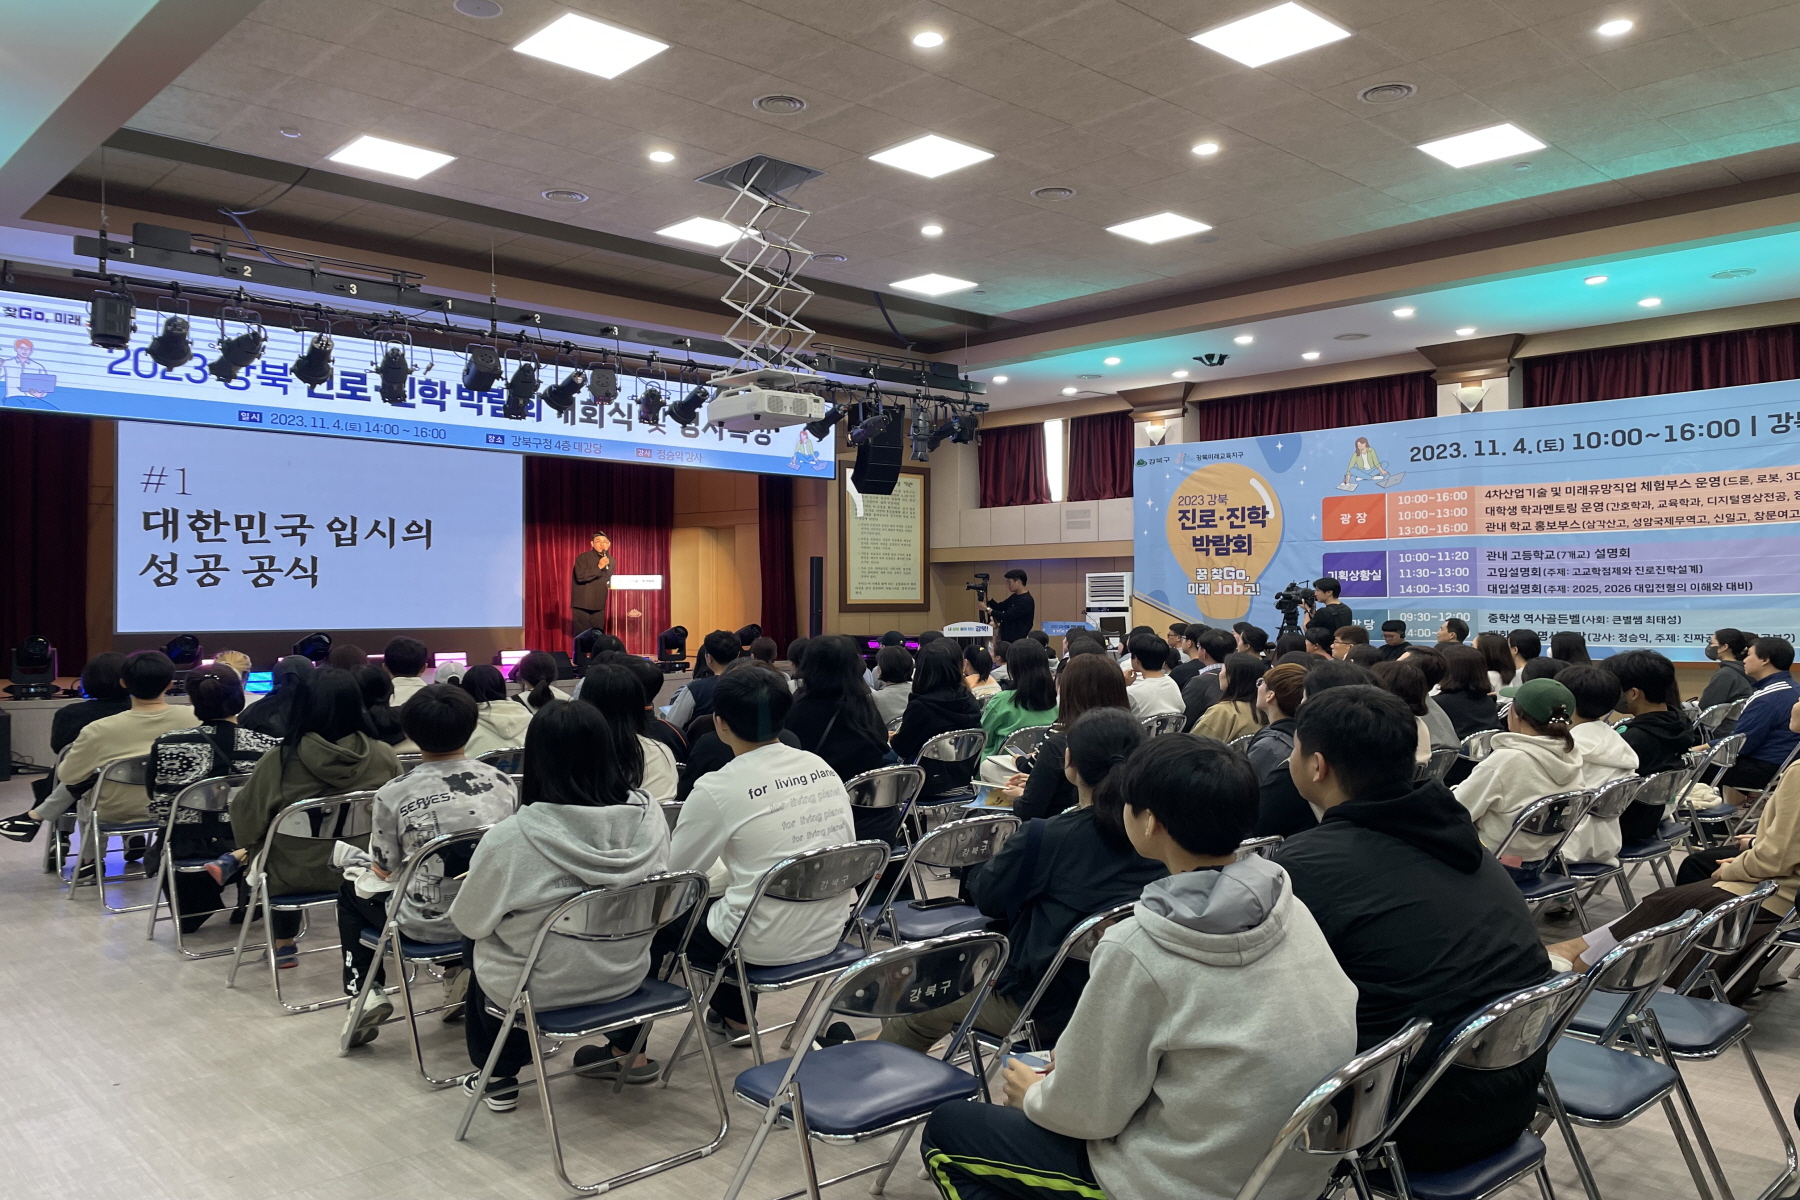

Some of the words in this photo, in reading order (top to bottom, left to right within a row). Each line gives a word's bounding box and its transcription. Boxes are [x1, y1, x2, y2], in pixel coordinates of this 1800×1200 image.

[128, 247, 135, 258] 1
[243, 265, 252, 277] 2
[349, 283, 358, 295] 3
[446, 299, 452, 309] 1
[54, 312, 81, 326] 미래
[534, 313, 541, 324] 2
[240, 411, 261, 423] 일시
[270, 412, 307, 428] 2023.
[311, 416, 331, 430] 11.
[365, 421, 399, 436] 14:00
[413, 426, 446, 440] 16:00
[487, 434, 504, 445] 장소
[511, 436, 552, 451] 강북구청
[554, 439, 570, 452] 4층
[573, 441, 603, 454] 대강당
[1410, 441, 1467, 462] 2023.
[1474, 439, 1507, 456] 11.
[1572, 418, 1740, 450] 10:00~16:00
[657, 449, 684, 462] 정승익
[686, 450, 703, 463] 강사
[140, 465, 192, 496] #1
[1485, 487, 1548, 499] 4차산업기술
[1551, 486, 1562, 497] 및
[1565, 481, 1637, 497] 미래유망직업
[1640, 478, 1692, 492] 체험부스
[1756, 473, 1783, 484] 로봇,
[1178, 495, 1205, 506] 2023
[1207, 494, 1229, 506] 강북
[1398, 491, 1468, 505] 10:00~16:00
[1485, 505, 1517, 516] 대학생
[1520, 503, 1577, 515] 학과멘토링
[1657, 497, 1703, 508] 교육학과,
[1707, 491, 1790, 506] 디지털영상전공,
[1178, 505, 1269, 530] 진로·진학
[1398, 507, 1468, 521] 10:00~13:00
[141, 506, 315, 547] 대한민국
[326, 514, 433, 551] 입시의
[1485, 521, 1507, 532] 관내
[1510, 520, 1532, 531] 학교
[1632, 514, 1710, 527] 성암국제무역고,
[1713, 512, 1751, 523] 신일고,
[1398, 523, 1468, 536] 13:00~16:00
[1191, 534, 1252, 556] 박람회
[1399, 551, 1469, 563] 10:00~11:20
[1486, 550, 1508, 561] 관내
[1594, 547, 1630, 559] 설명회
[139, 551, 230, 588] 성공
[241, 553, 319, 589] 공식
[1196, 568, 1208, 580] 꿈
[1211, 566, 1250, 582] 찾Go,
[1328, 569, 1382, 581] 기획상황실
[1399, 567, 1469, 578] 11:30~13:00
[1572, 566, 1632, 576] 고교학점제와
[1634, 564, 1703, 575] 진로진학설계)
[1187, 583, 1211, 595] 미래
[1213, 581, 1261, 596] Job고!
[1400, 583, 1470, 594] 14:00~15:30
[1572, 584, 1602, 594] 2025,
[1604, 584, 1631, 593] 2026
[1634, 583, 1687, 593] 대입전형의
[1690, 582, 1723, 592] 이해와
[1726, 581, 1753, 592] 대비)
[1488, 613, 1520, 624] 중학생
[1612, 615, 1642, 625] 큰별쌤
[1645, 615, 1682, 625] 최태성)
[1618, 633, 1652, 644] 정승익,
[1655, 633, 1680, 643] 주제:
[748, 785, 768, 799] for
[775, 775, 808, 789] living
[810, 769, 837, 783] plane
[909, 979, 951, 1003] 강북구
